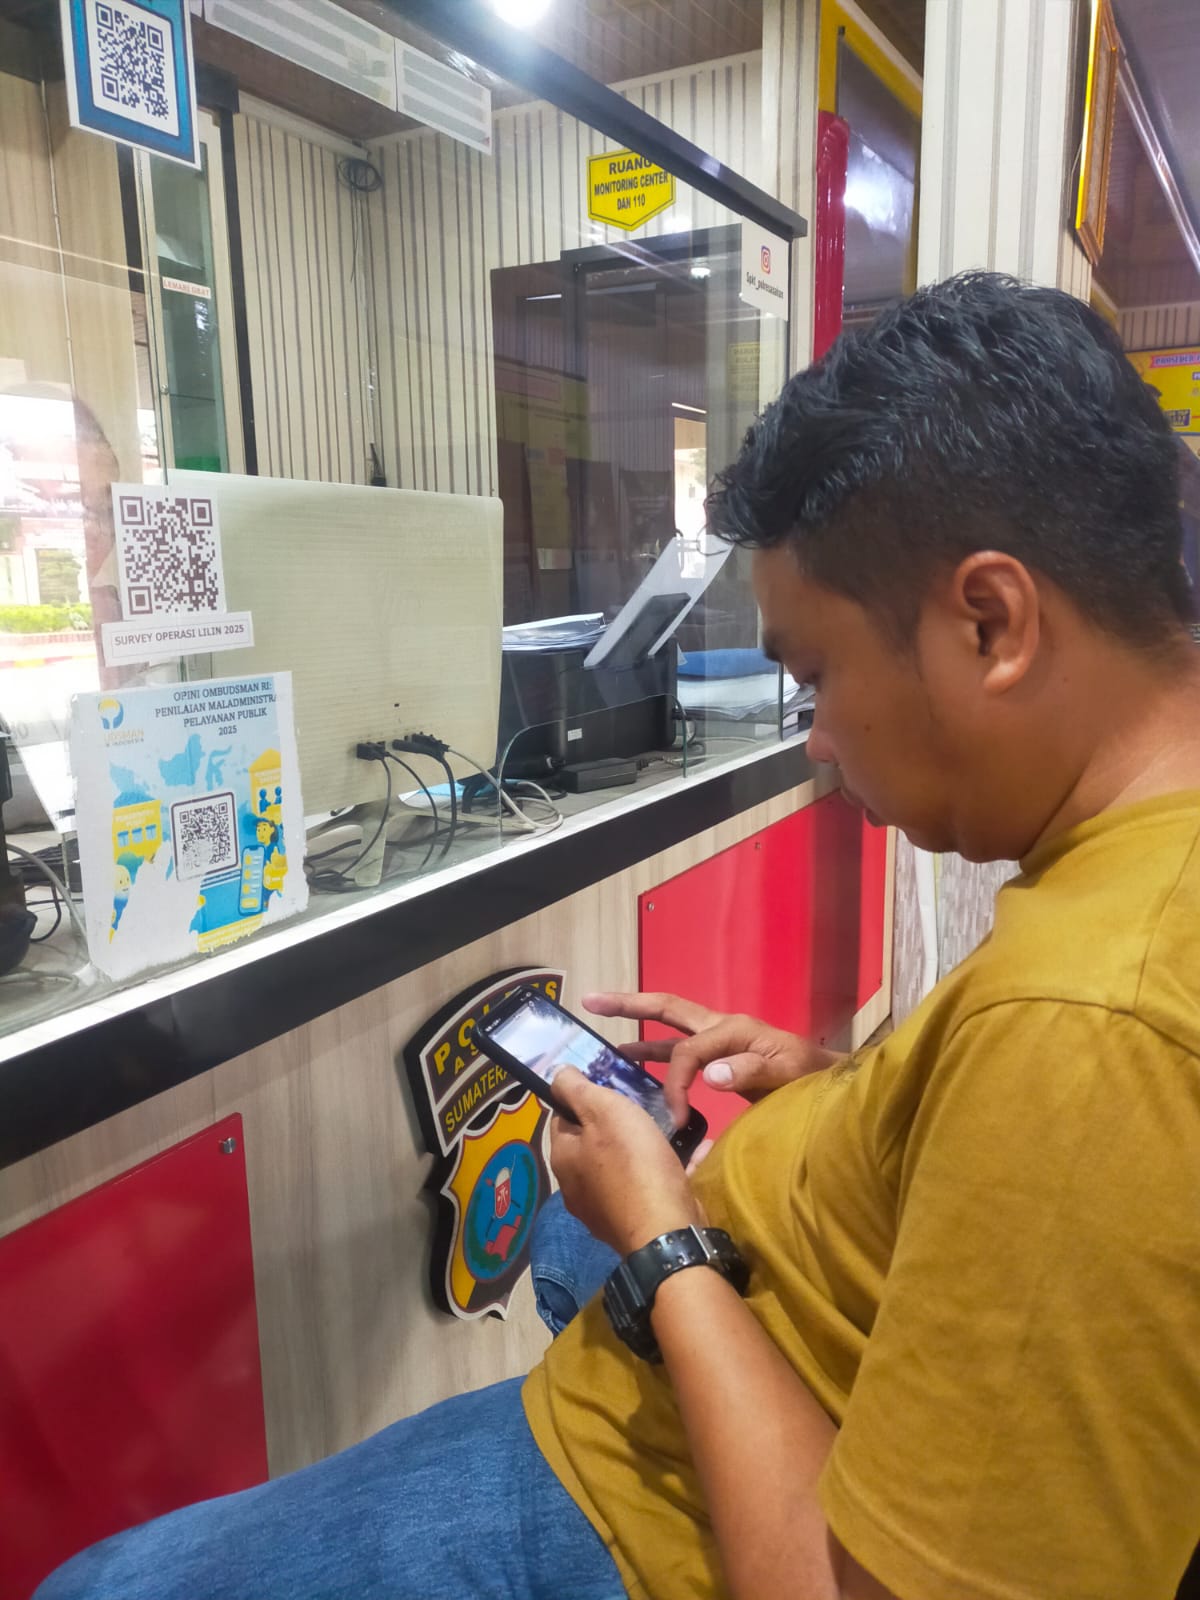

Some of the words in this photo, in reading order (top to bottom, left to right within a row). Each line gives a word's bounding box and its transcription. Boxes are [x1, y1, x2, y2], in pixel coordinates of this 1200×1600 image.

[593, 175, 639, 196] MONITORING
[639, 170, 669, 188] CENTER
[616, 197, 631, 211] DAN
[633, 193, 646, 208] 110
[114, 633, 153, 647] SURVEY
[155, 629, 196, 642] OPERASI
[198, 625, 222, 638] LILIN
[224, 624, 245, 635] 2025
[173, 689, 200, 702] OPINI
[202, 683, 259, 699] OMBUDSMAN
[155, 702, 206, 718] PENILAIAN
[183, 712, 236, 728] PELAYANAN
[237, 707, 268, 720] PUBLIK
[218, 724, 238, 737] 2025
